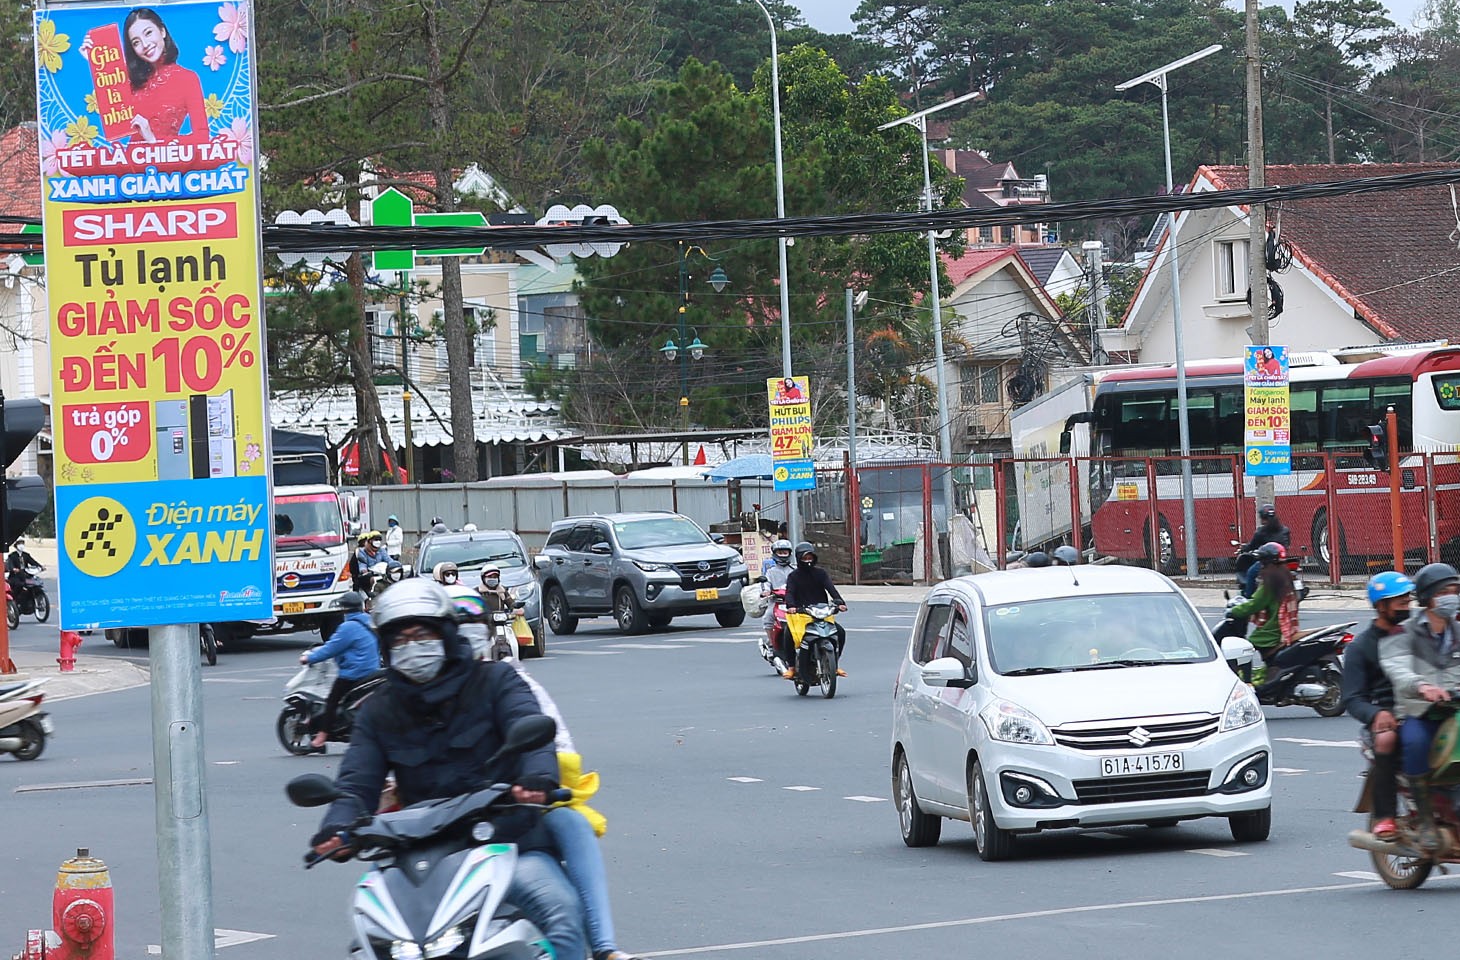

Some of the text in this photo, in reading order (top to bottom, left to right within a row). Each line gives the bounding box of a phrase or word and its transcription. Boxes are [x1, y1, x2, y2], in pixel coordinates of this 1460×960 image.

[90, 44, 120, 71] Gia
[107, 88, 121, 105] là
[103, 104, 133, 127] nhất
[57, 133, 238, 168] TẾT LÀ CHIỀU TẤT
[50, 163, 247, 199] XANH GIẢM CHẤT
[73, 208, 227, 240] SHARP
[75, 246, 226, 293] Tủ lạnh
[57, 283, 251, 337] GIẢM SỐC
[59, 332, 255, 393] ĐẾN 10%
[1247, 406, 1269, 414] GIẢM
[1250, 396, 1285, 405] Máy lạnh
[72, 405, 141, 429] trả góp
[772, 416, 810, 425] PHILIPS
[1247, 416, 1266, 427] ĐẾN
[90, 426, 128, 461] 0%
[146, 498, 264, 531] Điện máy
[140, 528, 264, 567] XANH
[1104, 754, 1181, 774] 61A-415.78
